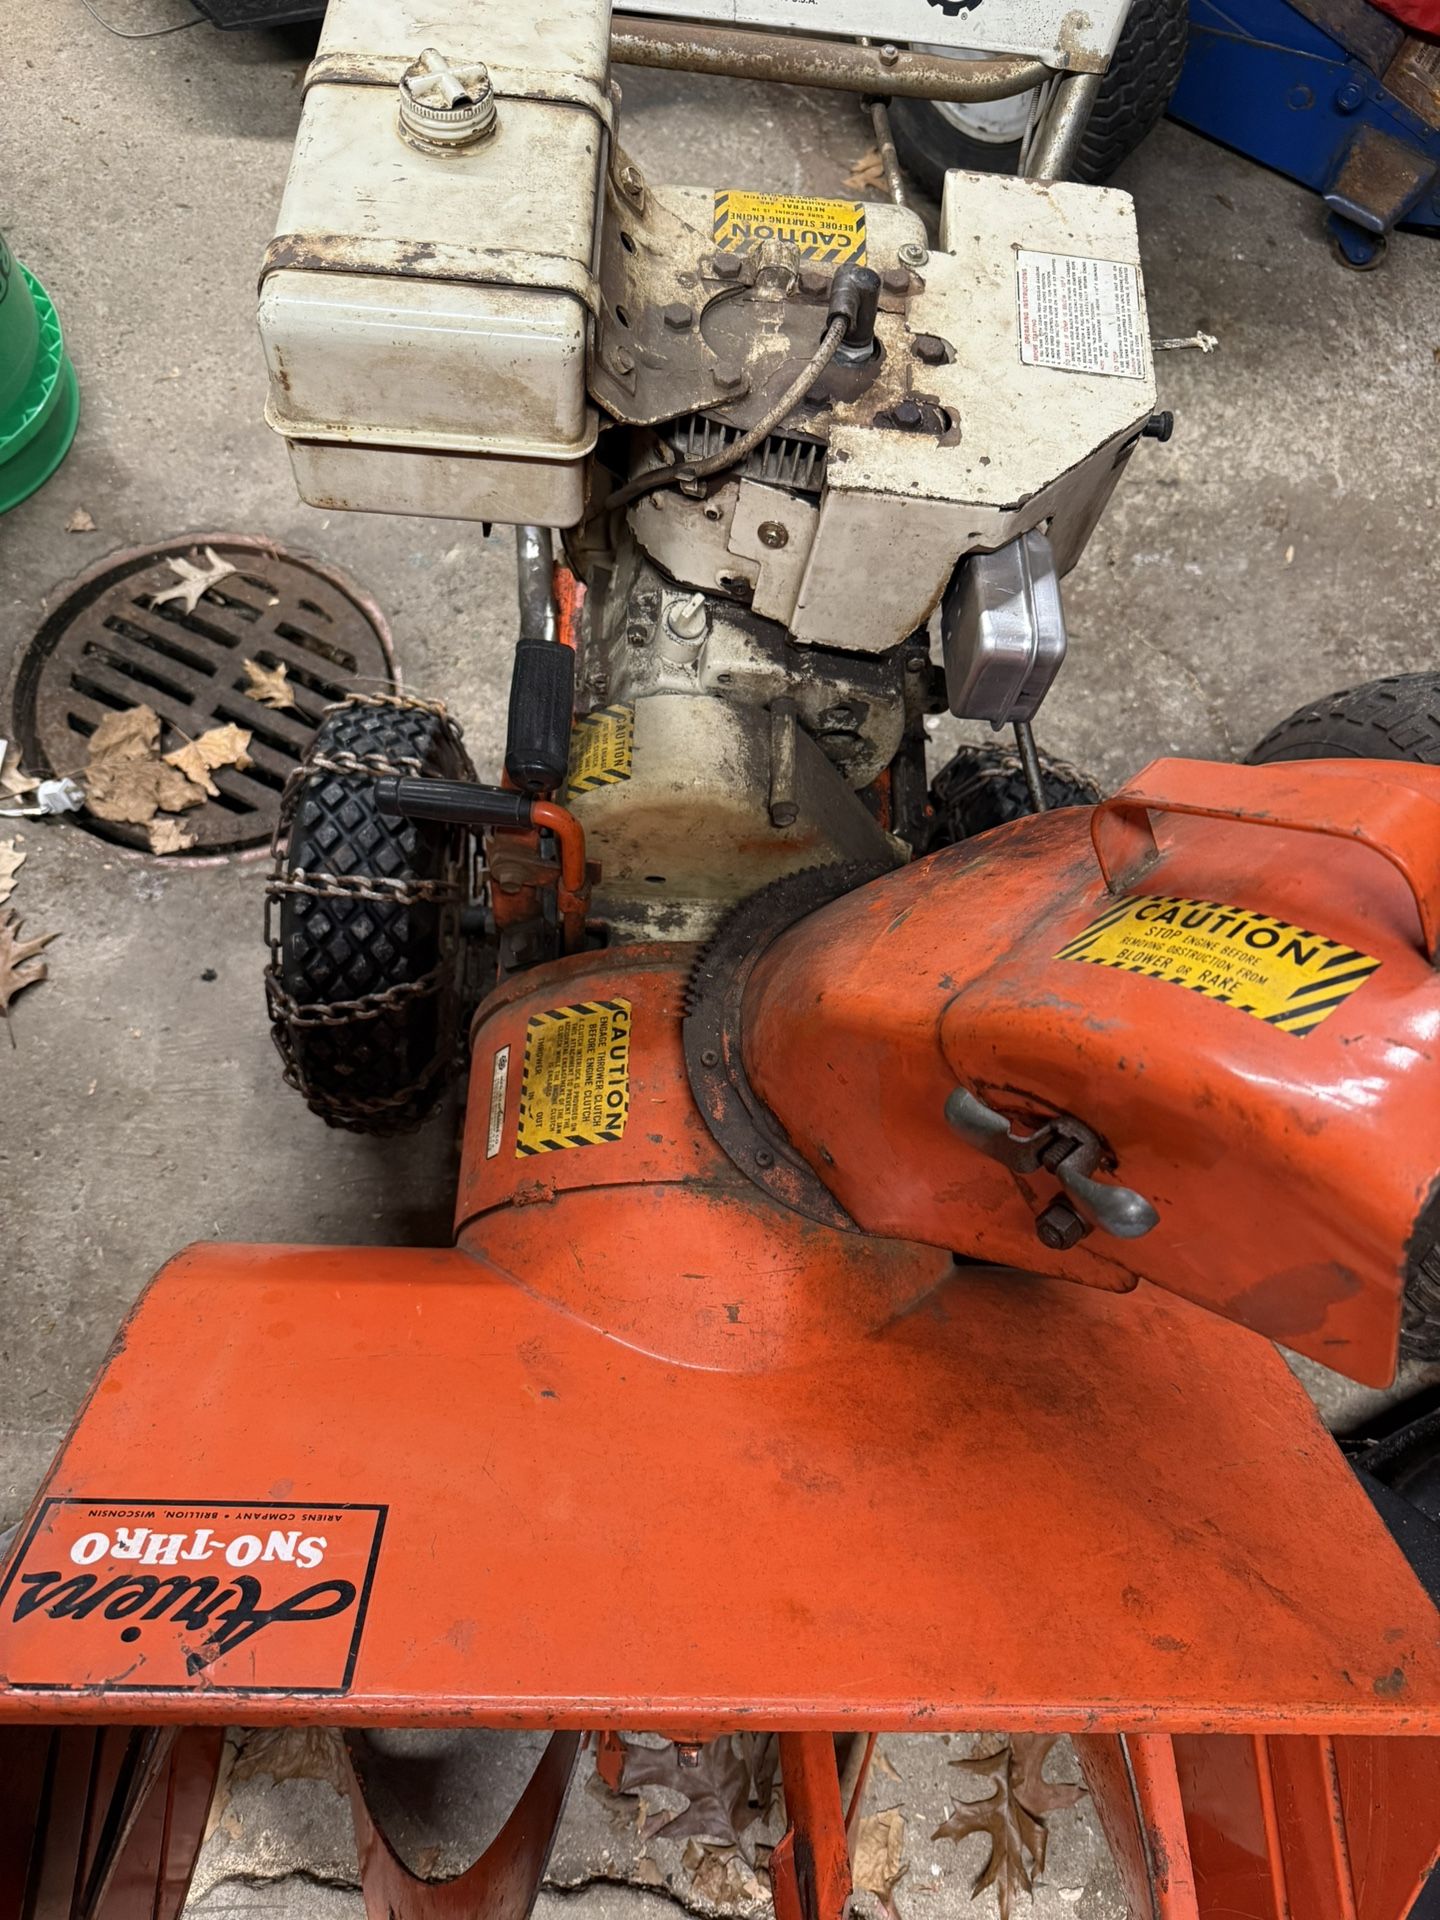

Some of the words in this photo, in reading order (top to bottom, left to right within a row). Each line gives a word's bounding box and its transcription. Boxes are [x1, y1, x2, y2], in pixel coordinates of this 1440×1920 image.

[730, 212, 765, 223] ENGINE
[769, 216, 815, 228] STARTING
[782, 203, 825, 212] NEUTRAL
[731, 223, 851, 247] CAUTION
[820, 222, 853, 232] BEFORE
[614, 718, 625, 766] CAUTION
[1134, 903, 1320, 967] CAUTION
[1144, 926, 1182, 940] STOP
[1183, 935, 1220, 952] ENGINE
[1219, 945, 1263, 967] BEFORE
[1116, 948, 1173, 969] BLOWER
[1176, 964, 1193, 976] OR
[1197, 969, 1243, 994] RAKE
[1120, 936, 1164, 953] REMOVING
[1167, 942, 1232, 972] OBSTRUCTION
[1235, 965, 1268, 986] FROM
[563, 1021, 571, 1055] ACCIDENTAL
[587, 1023, 597, 1053] BEFORE
[598, 1016, 608, 1047] ENGAGE
[534, 1037, 545, 1076] THROWER
[568, 1038, 576, 1076] ATTACHMENT
[585, 1057, 595, 1086] ENGINE
[595, 1051, 606, 1090] THROWER
[606, 1010, 628, 1130] CAUTION
[559, 1057, 568, 1096] ENGAGEMENT
[528, 1092, 534, 1100] IN
[558, 1098, 564, 1106] OF
[564, 1089, 572, 1116] PREVENT
[571, 1091, 579, 1120] PROVIDED
[582, 1090, 592, 1122] CLUTCH
[592, 1094, 603, 1127] CLUTCH
[535, 1112, 543, 1128] OUT
[570, 1122, 576, 1132] ON
[88, 1509, 155, 1518] WISCONSIN
[163, 1511, 218, 1519] BRILLION,
[235, 1513, 295, 1522] COMPANY
[302, 1513, 342, 1522] ARIENS
[69, 1527, 328, 1568] SNO-THRO
[12, 1571, 356, 1677] Ariens
